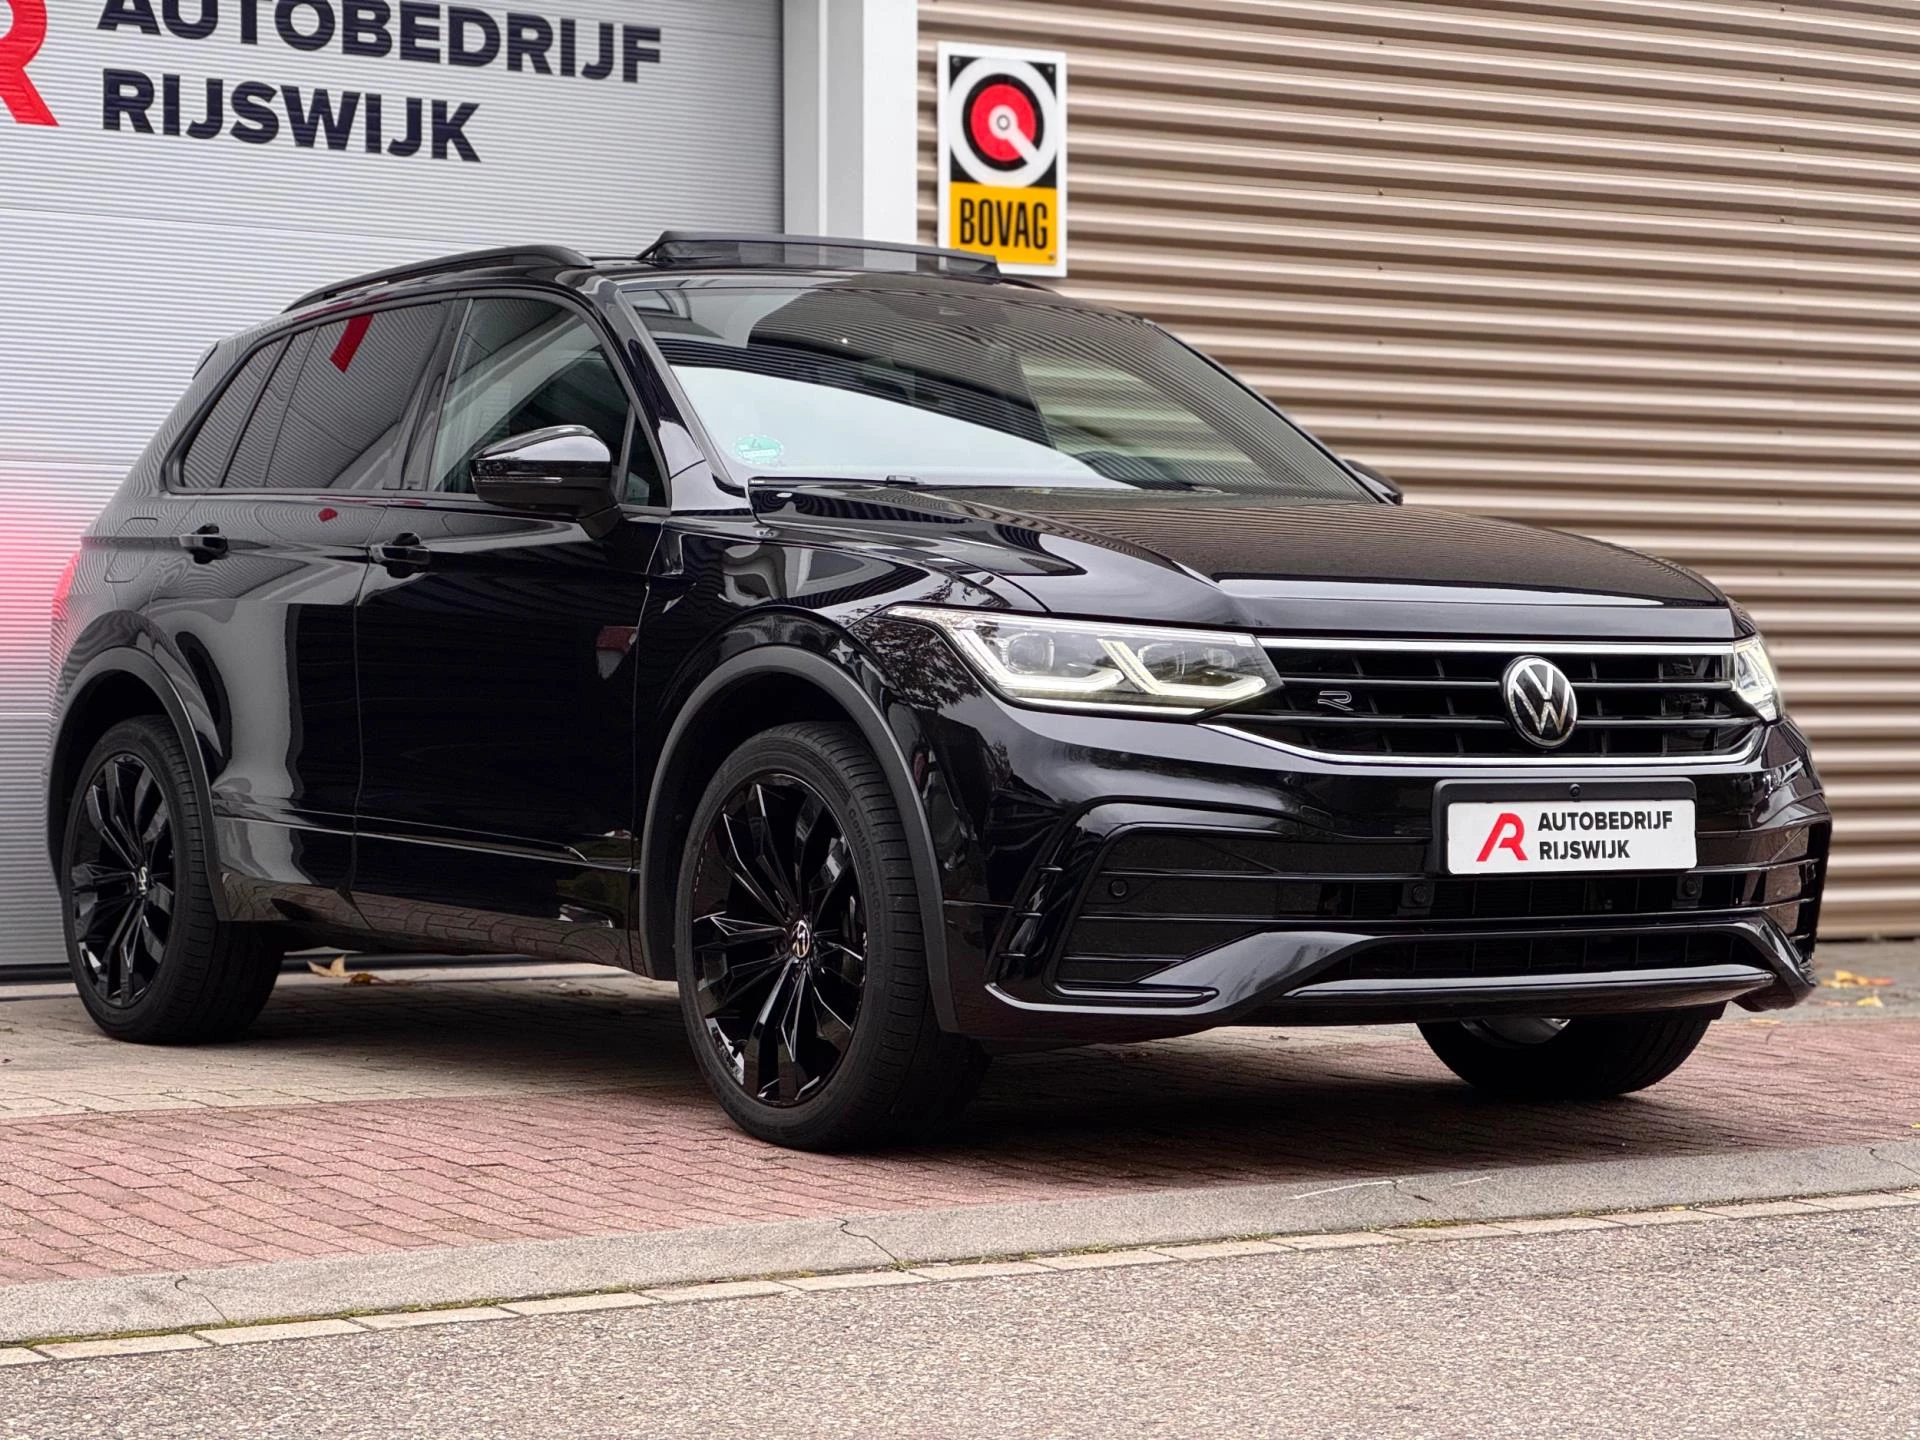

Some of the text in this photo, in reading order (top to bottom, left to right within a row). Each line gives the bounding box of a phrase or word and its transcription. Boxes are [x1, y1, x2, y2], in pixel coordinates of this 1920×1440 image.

[97, 0, 662, 83] AUTOBEDRIJF
[102, 68, 482, 163] RIJSWIJK
[959, 198, 1048, 250] BOVAG
[1537, 811, 1673, 831] AUTOBEDRIJF
[1539, 839, 1630, 860] RIJSWIJK
